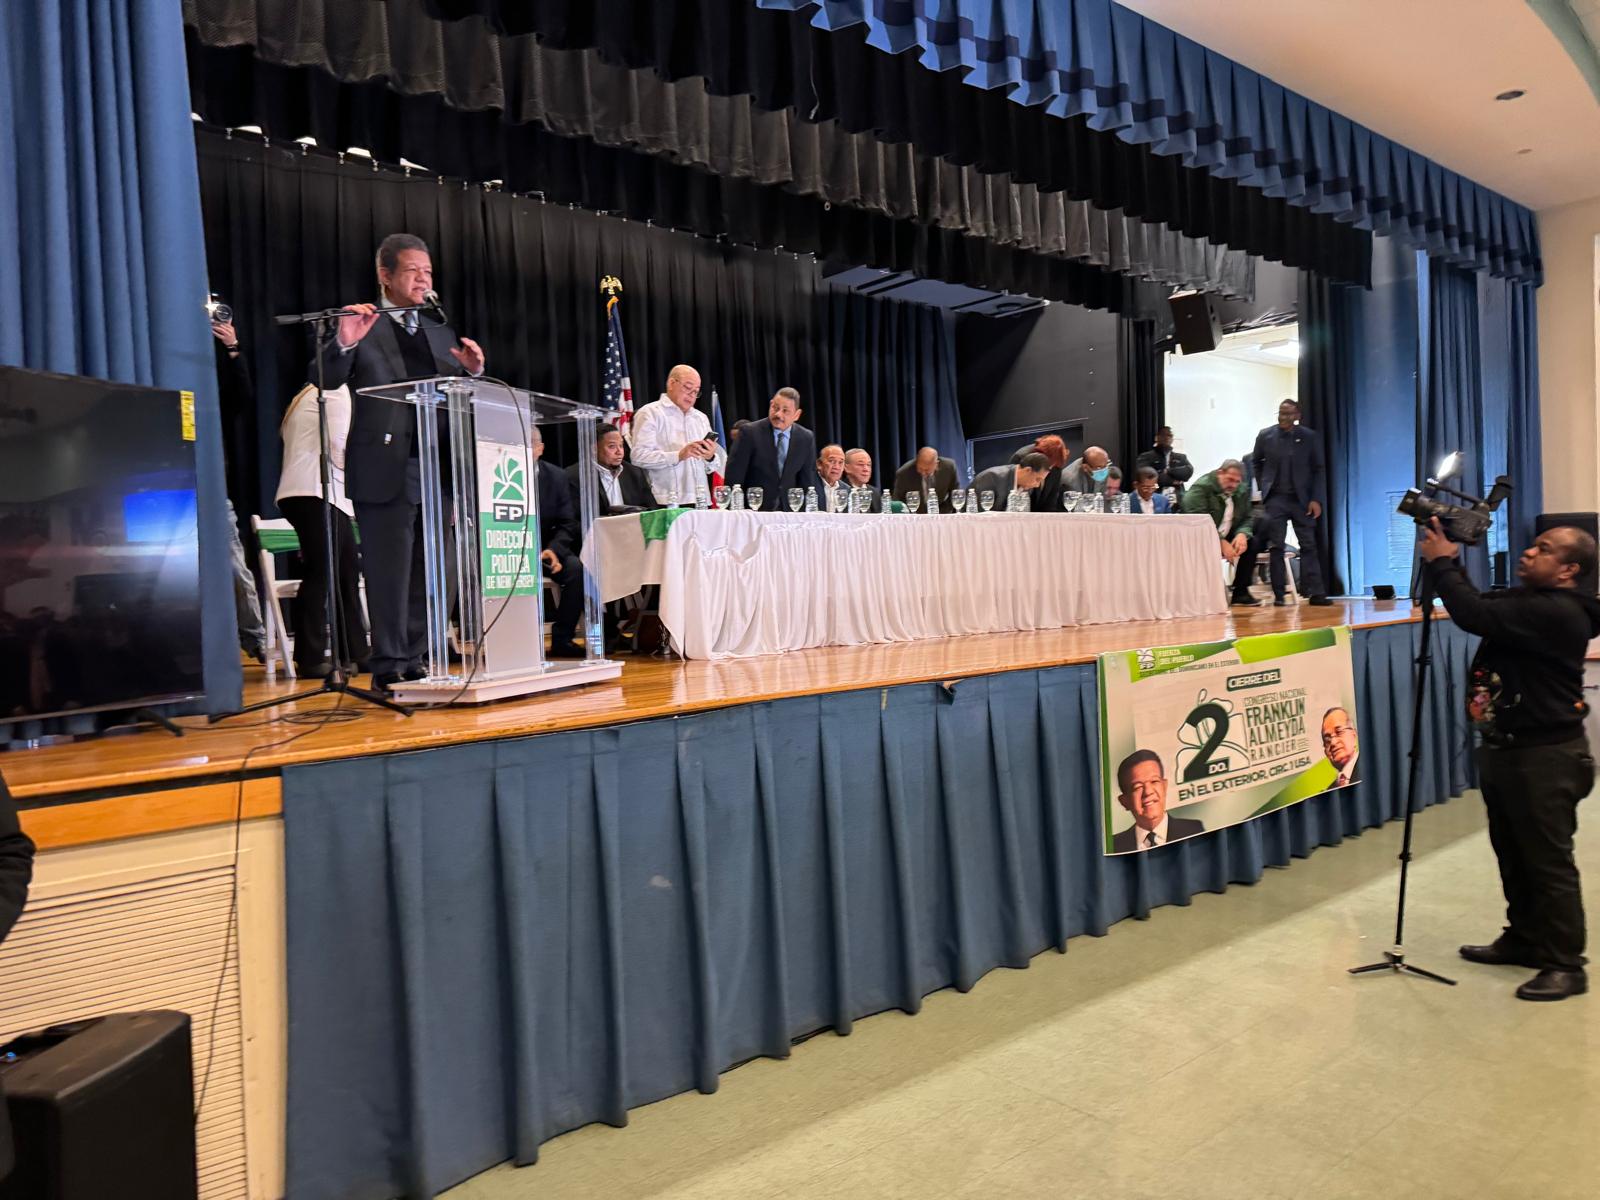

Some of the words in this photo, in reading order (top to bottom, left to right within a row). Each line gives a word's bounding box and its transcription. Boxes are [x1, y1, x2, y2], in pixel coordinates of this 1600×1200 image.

[495, 506, 523, 520] FP
[486, 526, 533, 548] DIRECCIÓN
[491, 549, 531, 574] POLÍTICA
[1229, 674, 1263, 688] CIERRE
[1263, 672, 1281, 683] DEL
[1245, 697, 1306, 728] FRANKLIN
[1183, 702, 1231, 781] 2
[1249, 717, 1306, 747] ALMEYDA
[1250, 739, 1297, 761] RANCIER
[1178, 786, 1195, 801] EN
[1197, 784, 1211, 796] EL
